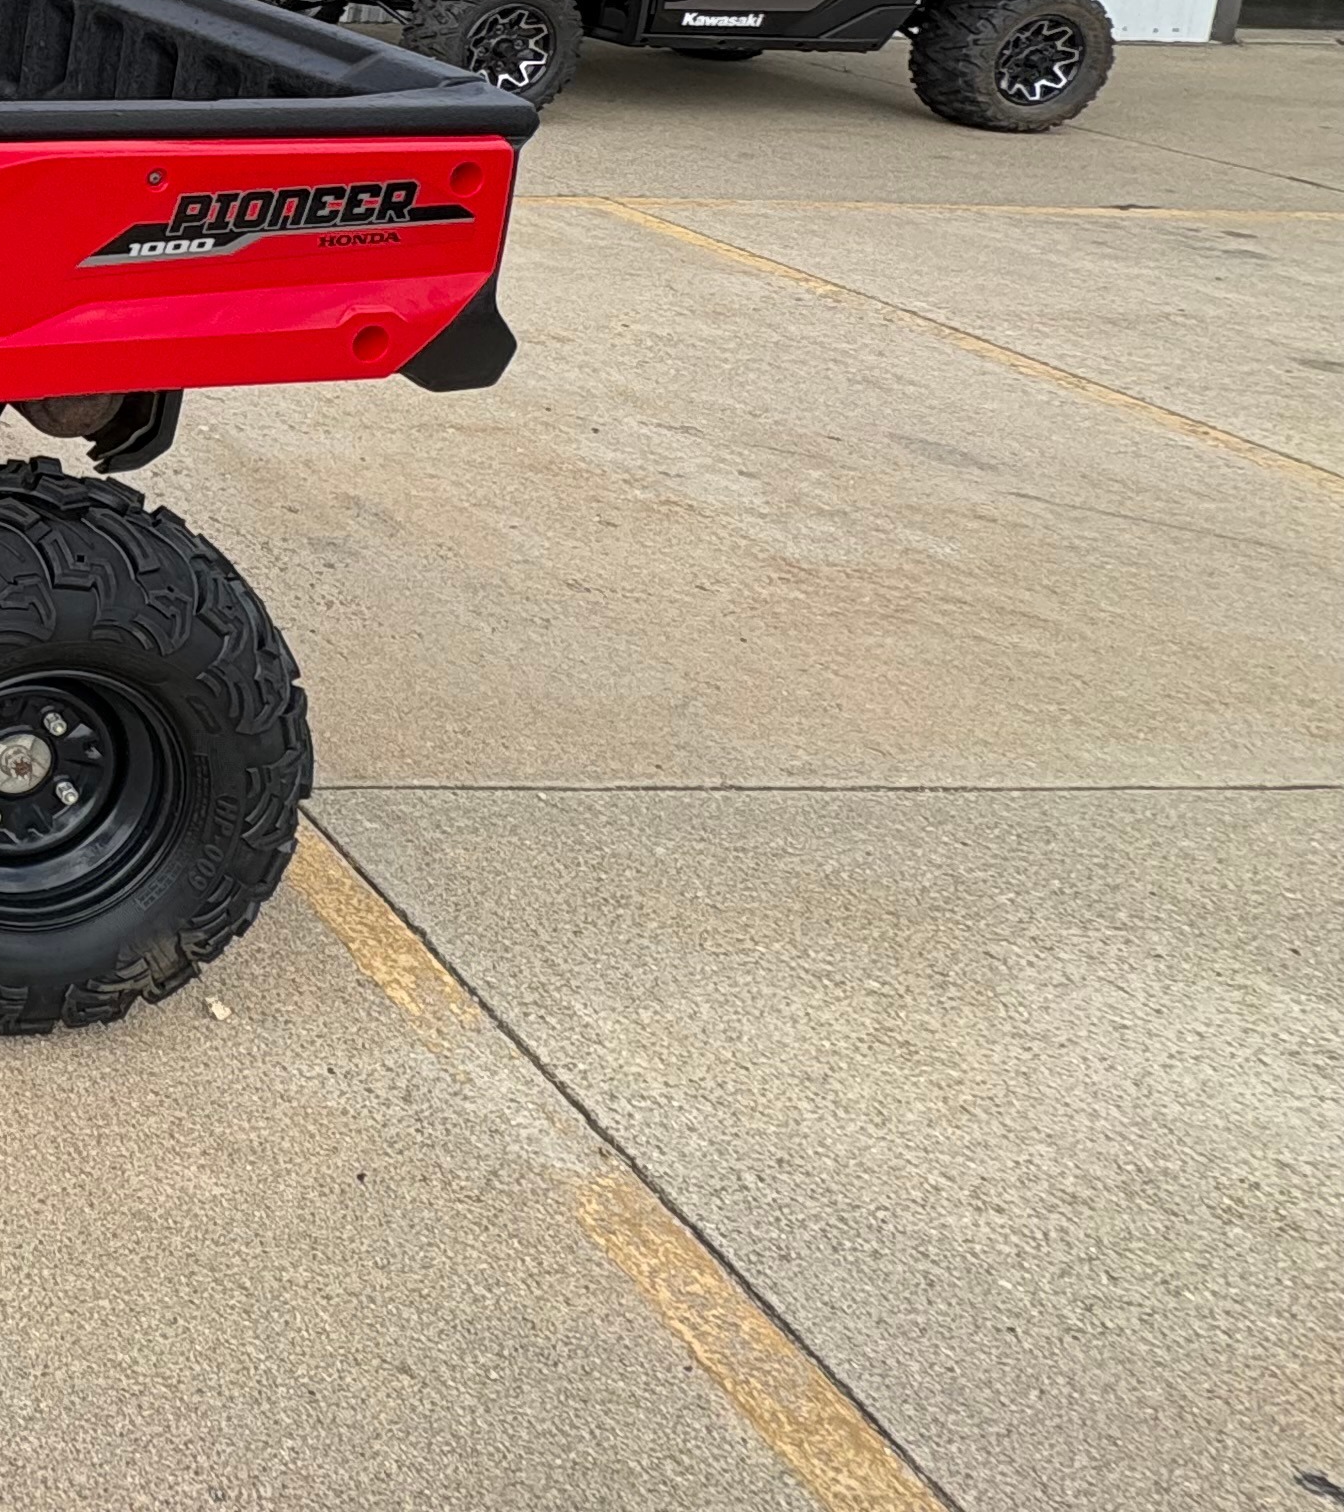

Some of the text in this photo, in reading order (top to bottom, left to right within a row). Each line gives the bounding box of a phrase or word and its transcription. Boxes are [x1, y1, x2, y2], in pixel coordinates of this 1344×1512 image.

[681, 12, 764, 27] Kawasaki
[165, 179, 419, 236] PIONEER
[128, 238, 215, 257] 1000
[316, 231, 401, 249] HONDA
